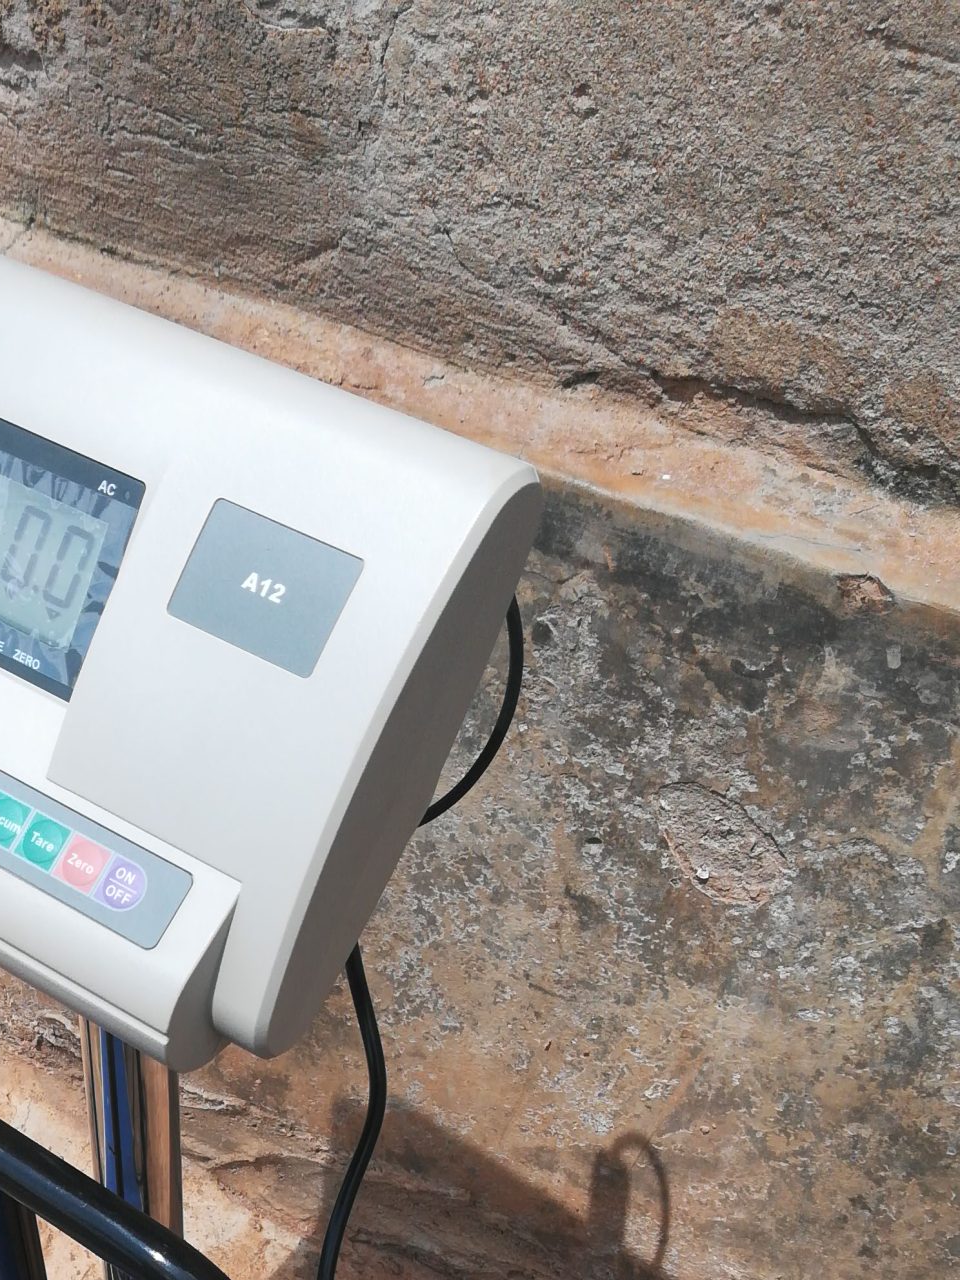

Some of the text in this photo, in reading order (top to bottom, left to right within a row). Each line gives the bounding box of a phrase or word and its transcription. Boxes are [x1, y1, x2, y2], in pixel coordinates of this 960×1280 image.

[97, 479, 117, 496] AC
[0, 505, 95, 609] 0.0
[240, 571, 287, 604] A12
[12, 648, 41, 670] ZERO
[30, 830, 55, 853] Tare
[67, 852, 95, 876] Zero
[115, 866, 137, 886] ON
[104, 883, 134, 907] OFF
